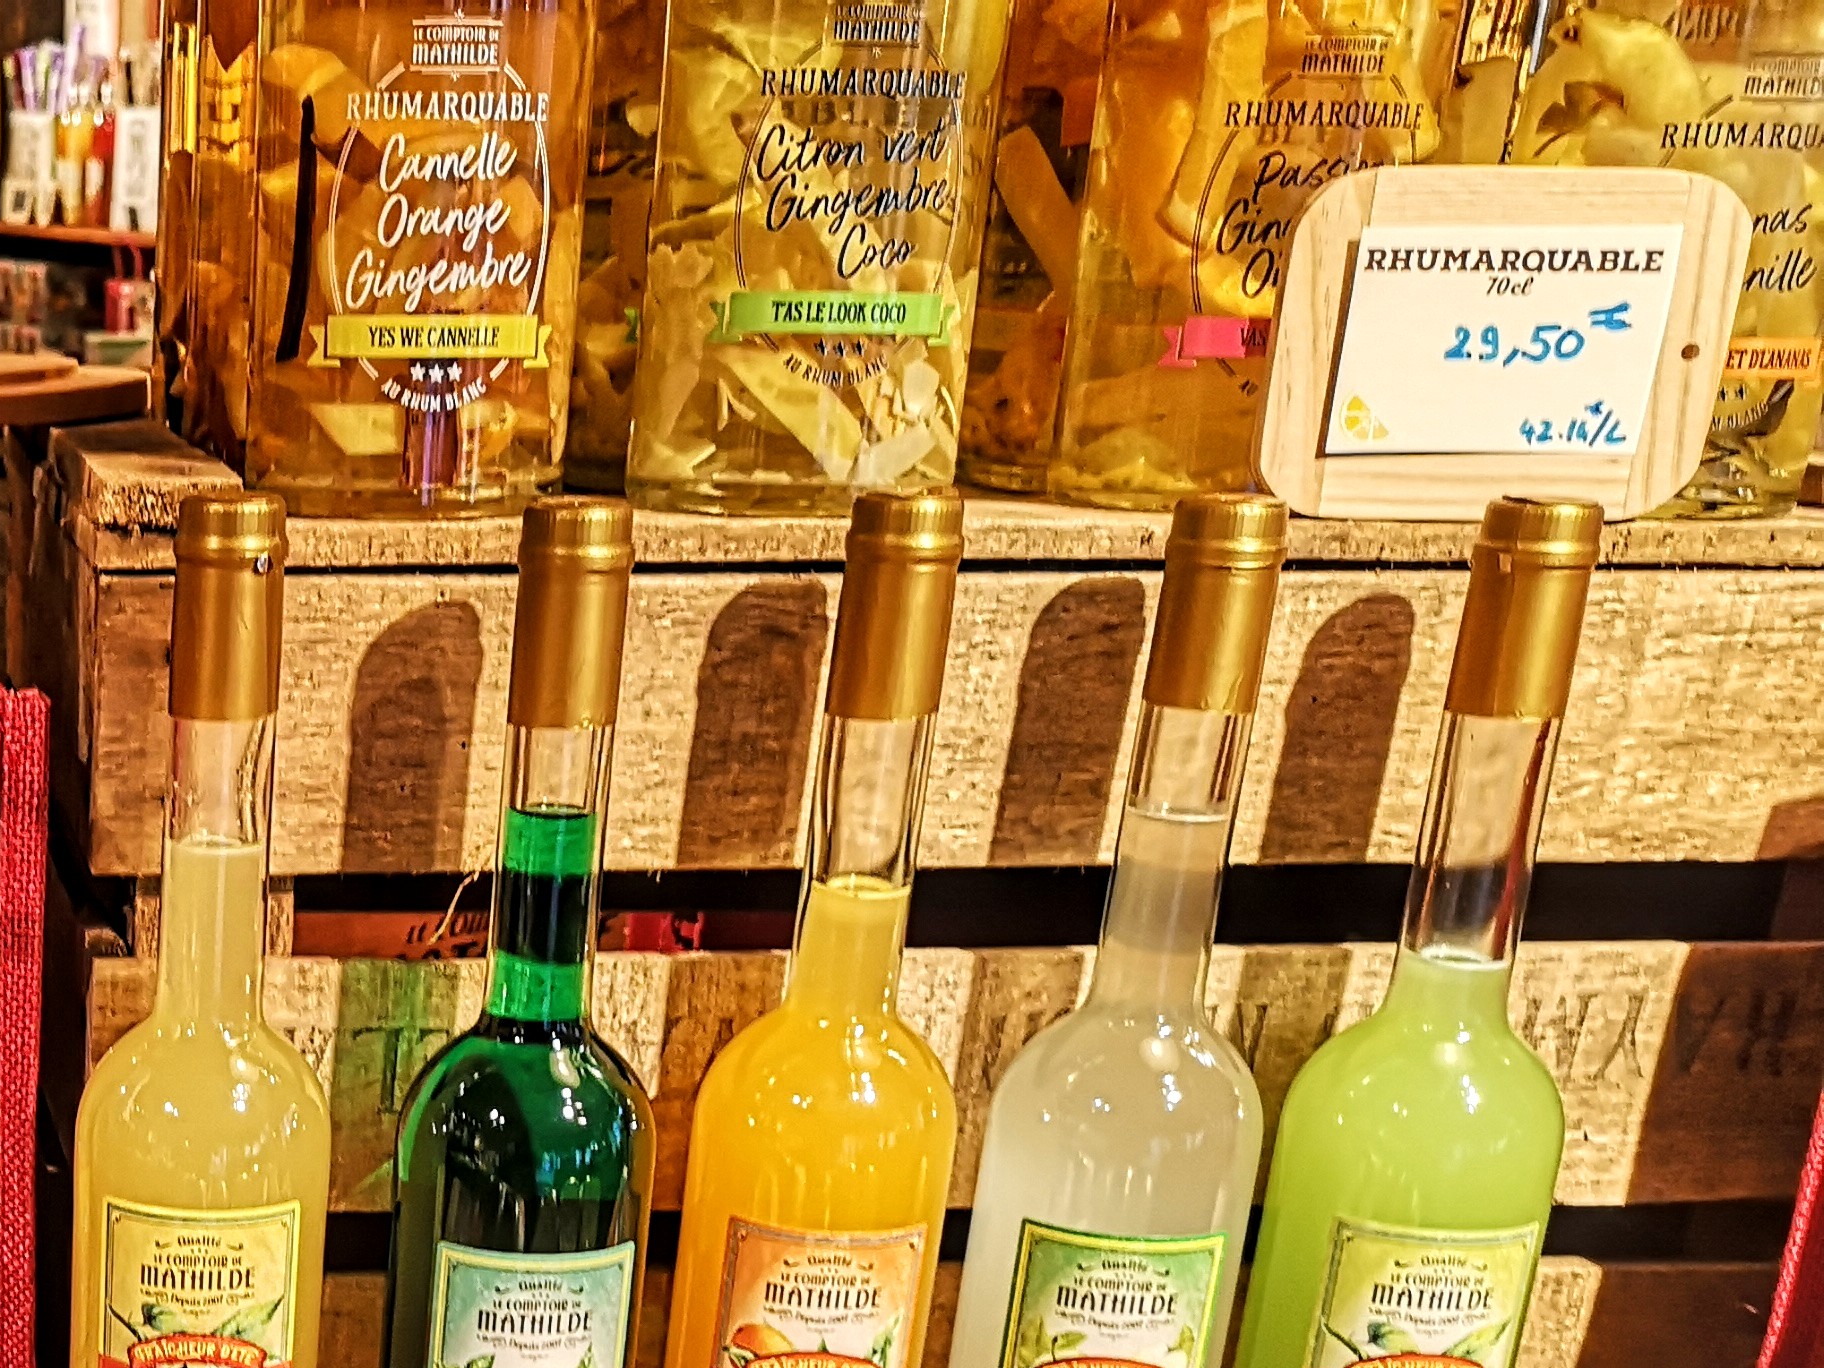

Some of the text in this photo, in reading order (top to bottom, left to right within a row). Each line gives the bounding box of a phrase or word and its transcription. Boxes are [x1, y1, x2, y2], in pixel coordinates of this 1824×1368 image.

[412, 44, 498, 65] MATHILDE
[1302, 54, 1385, 74] MATHILDE
[761, 68, 967, 99] RHUMARQUABLE
[346, 91, 548, 122] RHUMARQUABLE
[1224, 101, 1424, 130] RHUMARQUABLE
[379, 132, 517, 193] Cannelle
[756, 117, 948, 182] Citron vert
[766, 168, 948, 233] Gingembre
[378, 193, 511, 251] Orange
[837, 223, 916, 280] Coco
[1364, 247, 1663, 275] RHUMARQUABLE
[346, 242, 531, 312] Gingembre
[1486, 276, 1533, 297] 70cl
[806, 301, 825, 324] LE
[827, 300, 868, 324] LOOK
[871, 301, 907, 325] COCO
[369, 326, 500, 347] YES WE CANNELLE
[802, 363, 844, 388] RHUM
[400, 378, 486, 413] RHUM BLANC
[167, 1253, 229, 1269] COMPTOIR
[141, 1265, 255, 1291] MATHILDE
[794, 1272, 858, 1287] COMPTOIR
[765, 1281, 882, 1310] MATHILDE
[1056, 1285, 1178, 1316] MATHILDE
[1370, 1283, 1493, 1311] MATHILDE
[477, 1310, 592, 1335] MATHILDE
